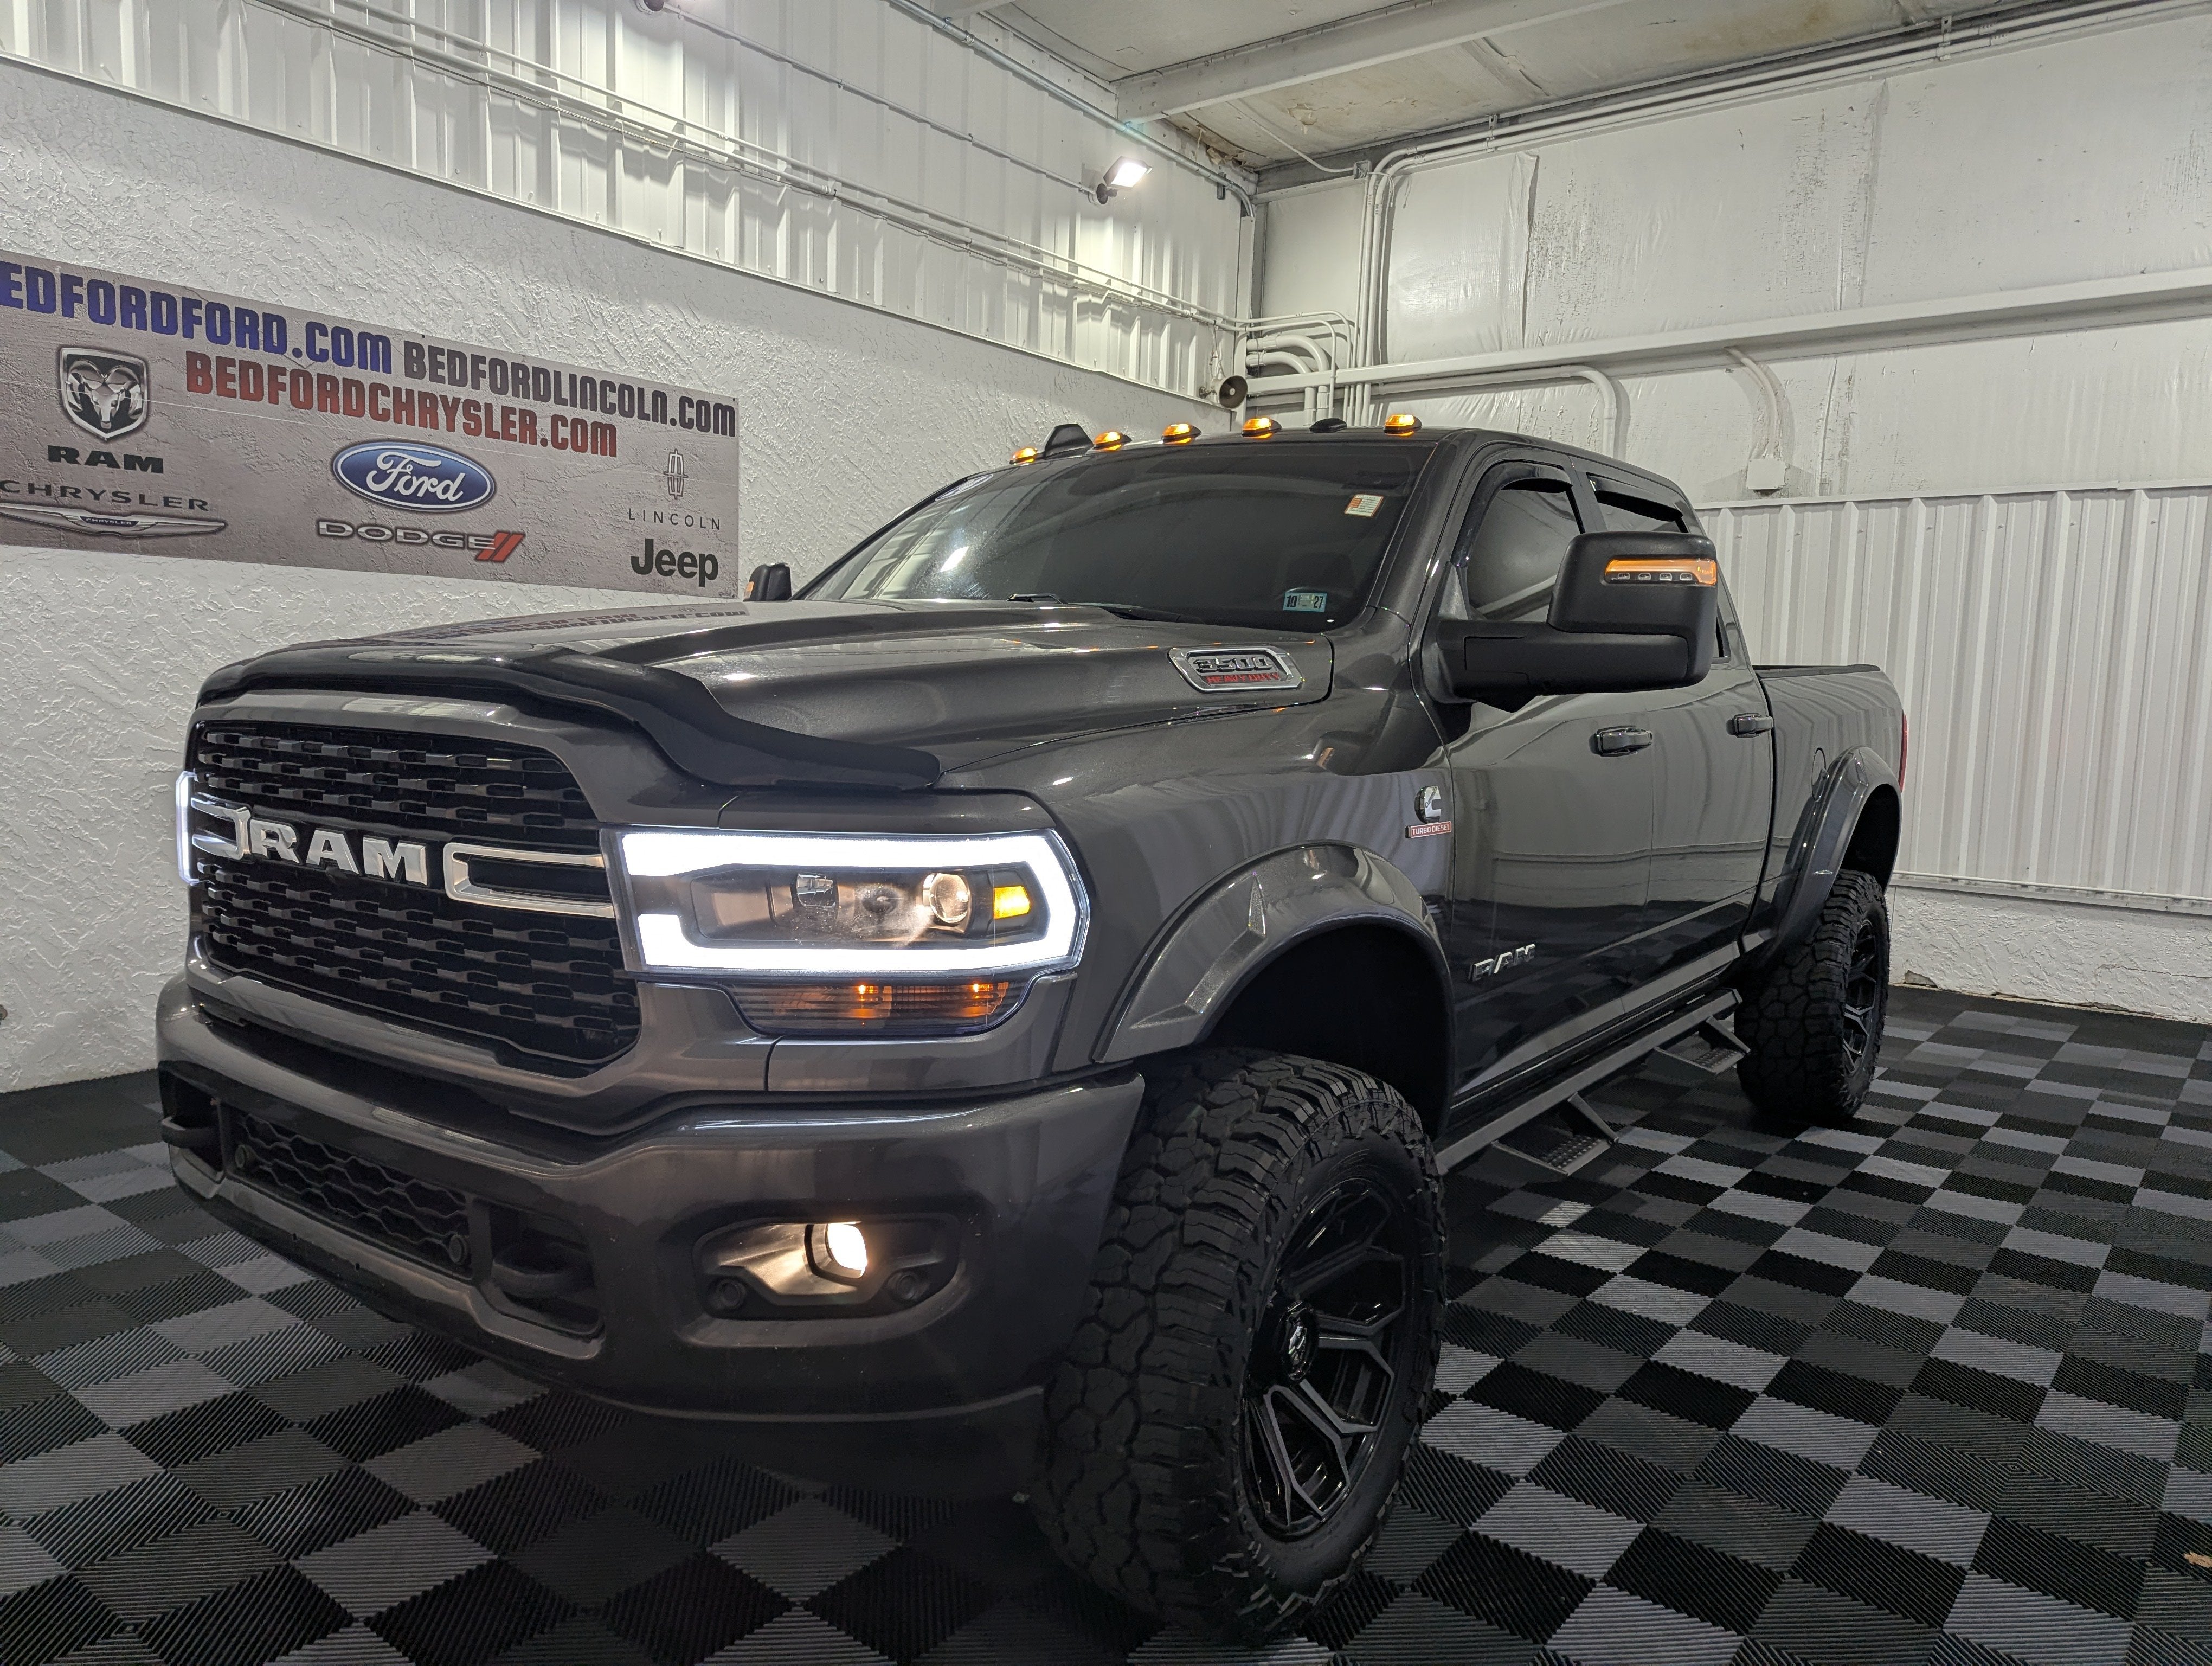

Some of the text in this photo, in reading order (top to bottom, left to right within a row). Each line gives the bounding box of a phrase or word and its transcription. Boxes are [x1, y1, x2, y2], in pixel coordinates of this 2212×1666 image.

[403, 339, 735, 438] BEDFORDLINCOLN.COM
[185, 350, 617, 458] BEDFORDCHRYSLER.COM
[47, 444, 164, 474] RAM
[366, 451, 466, 502] Ford
[0, 480, 209, 511] CHRYSLER
[628, 508, 720, 530] LINCOLN
[319, 521, 496, 550] DODGE
[631, 537, 719, 588] Jeep
[1313, 595, 1324, 609] 27
[1193, 657, 1272, 673] 3500
[1412, 824, 1451, 835] TURBO DIESEL
[249, 820, 429, 887] RAM
